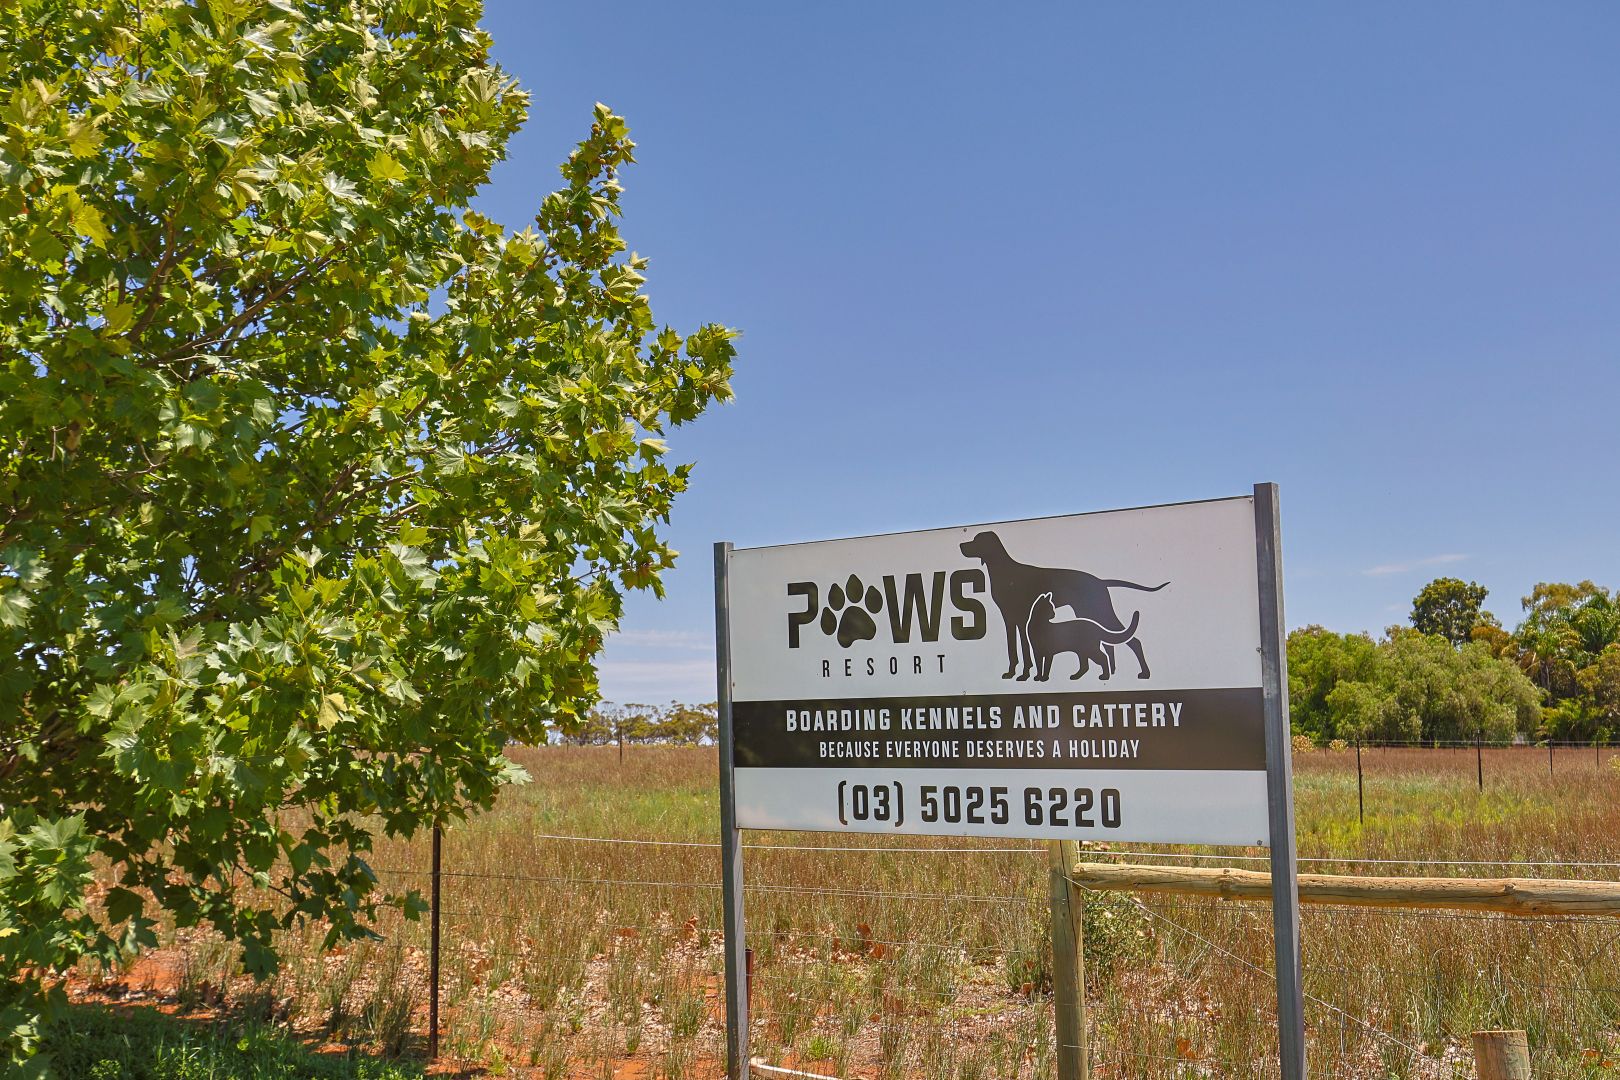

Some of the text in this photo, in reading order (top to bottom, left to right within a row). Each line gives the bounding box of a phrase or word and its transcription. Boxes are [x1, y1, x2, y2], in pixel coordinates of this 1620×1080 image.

[822, 654, 947, 678] RESORT
[786, 702, 1184, 732] BOARDING KENNELS AND CATTERY
[819, 739, 1141, 759] BECAUSE EVERYONE DESERVES A HOLIDAY
[837, 780, 1122, 829] (03) 5025 6220
